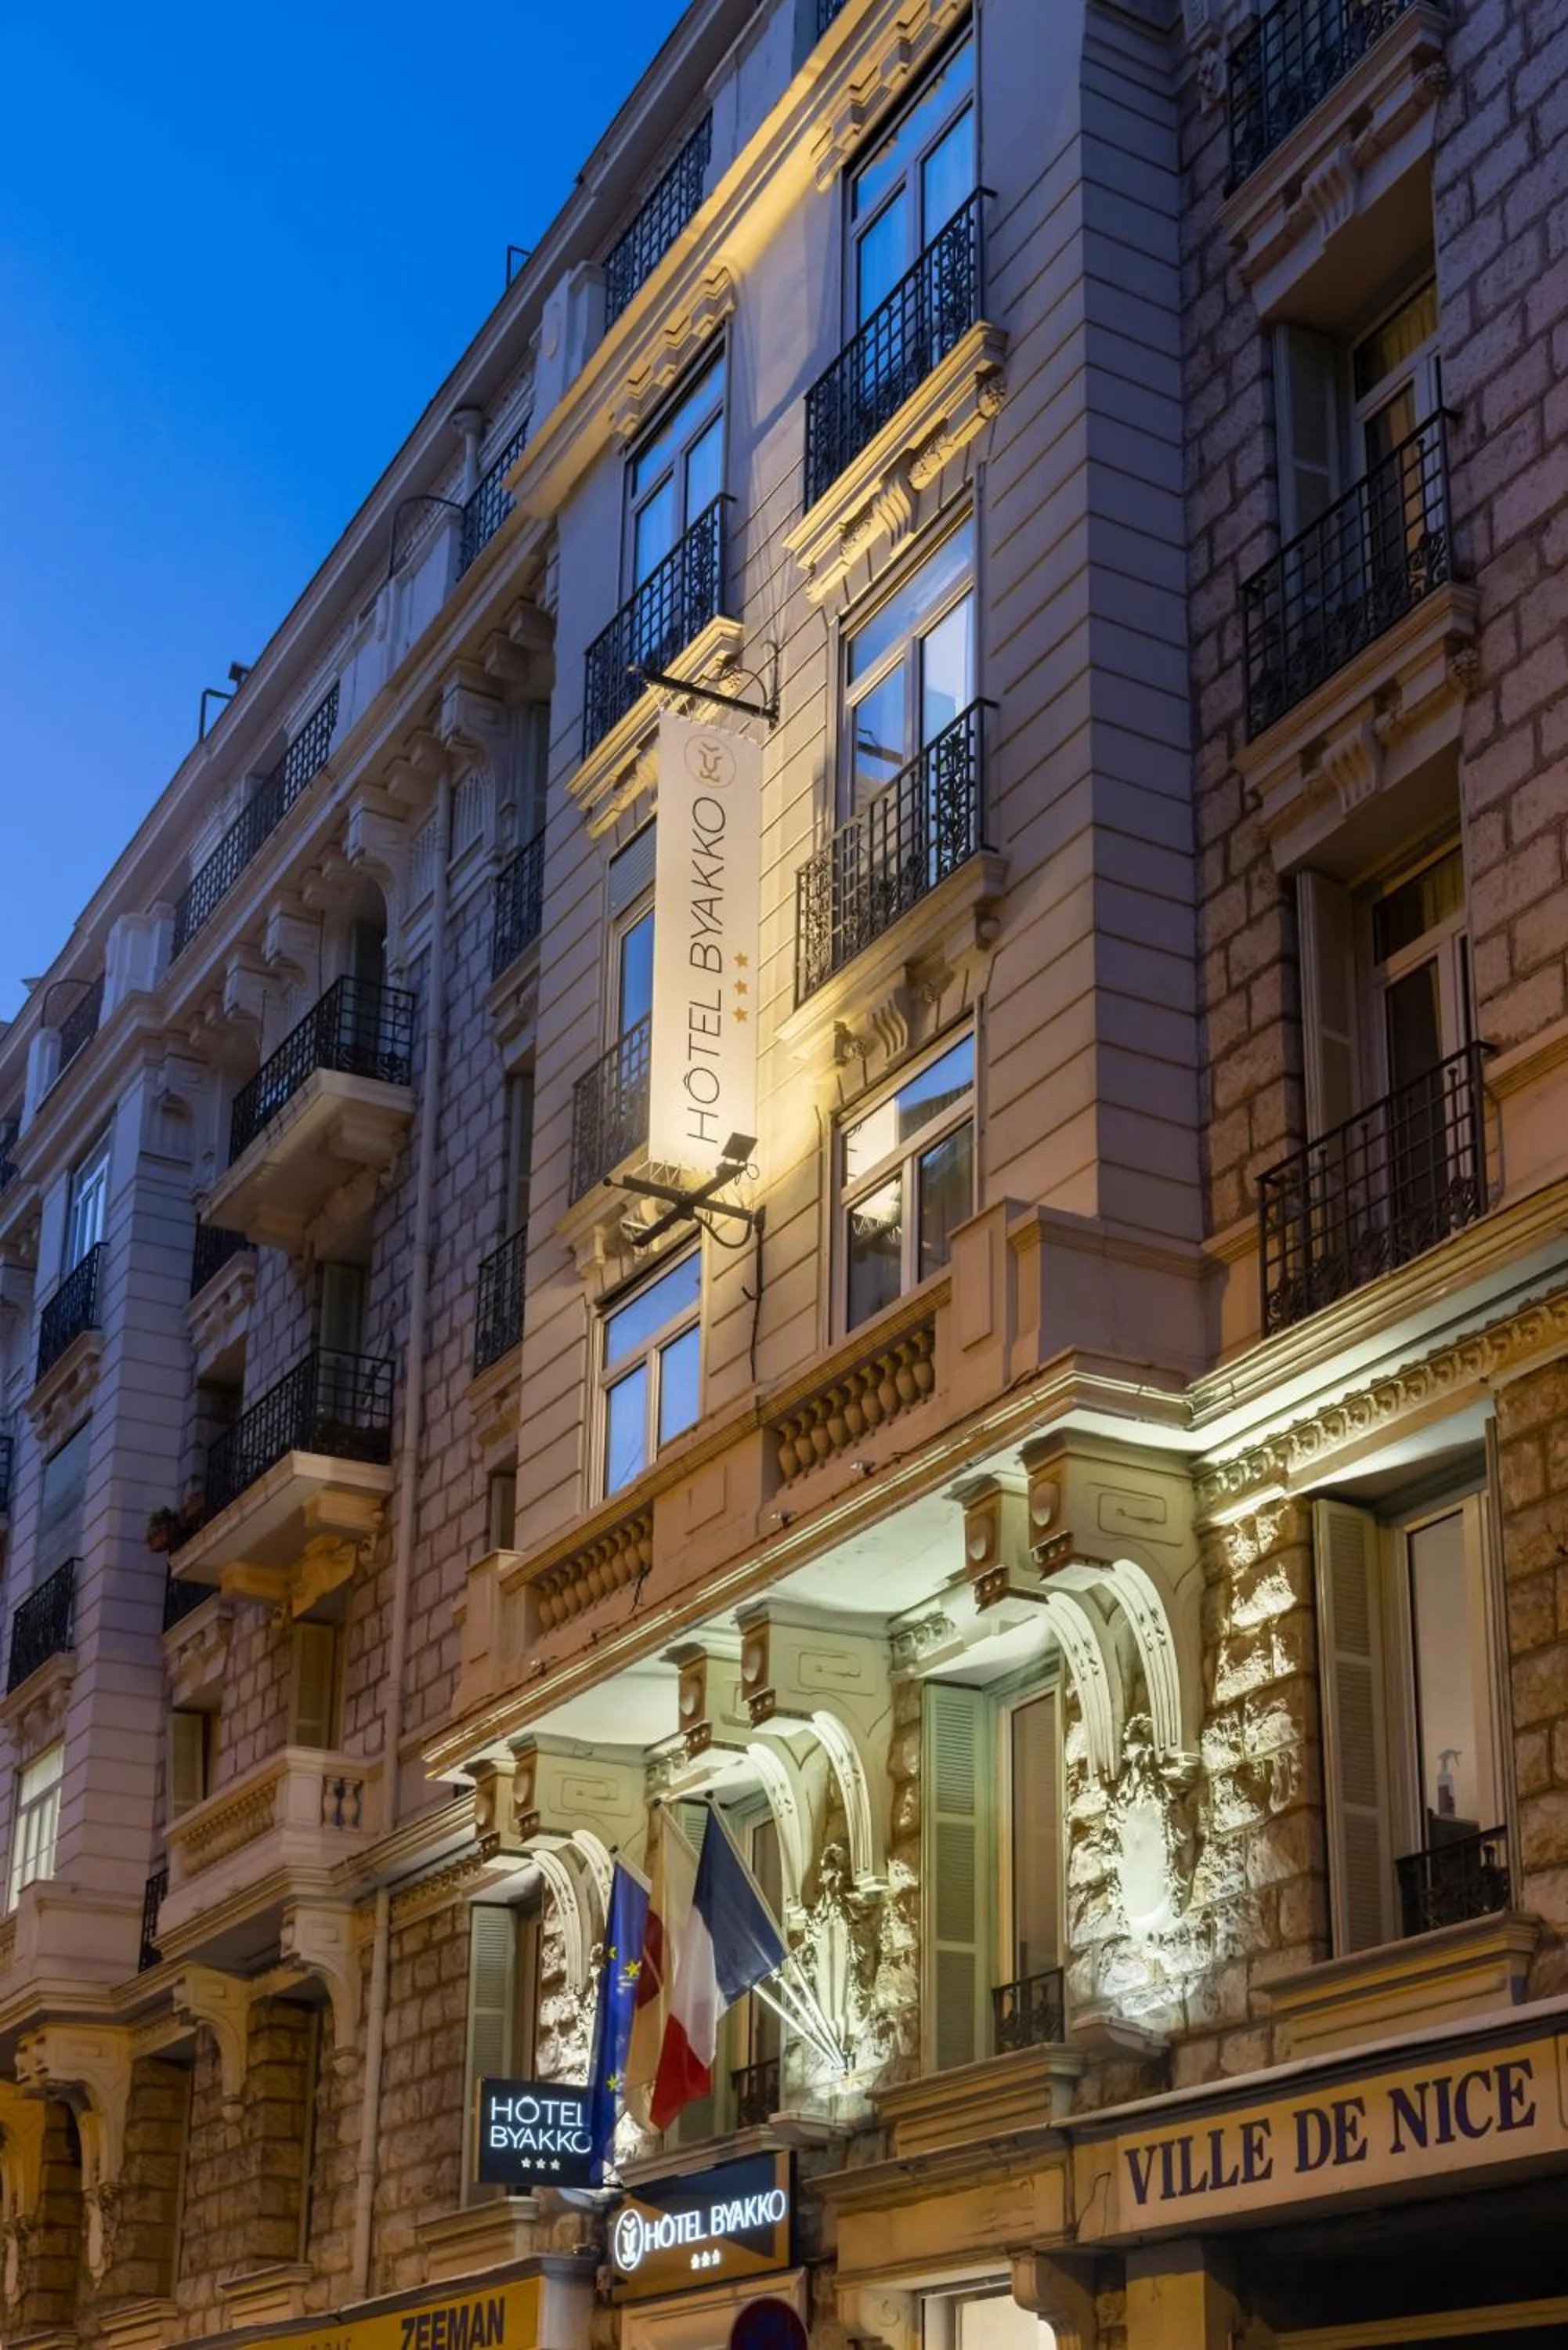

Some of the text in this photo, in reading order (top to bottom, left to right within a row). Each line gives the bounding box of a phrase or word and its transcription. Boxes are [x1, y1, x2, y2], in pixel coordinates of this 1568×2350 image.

[682, 797, 726, 1144] HÔTEL BYAKKO
[490, 2125, 593, 2153] BYAKKO
[1124, 2058, 1537, 2205] VILLE DE NICE
[710, 2189, 786, 2236] BYAKKO
[400, 2296, 505, 2350] ZEEMAN
